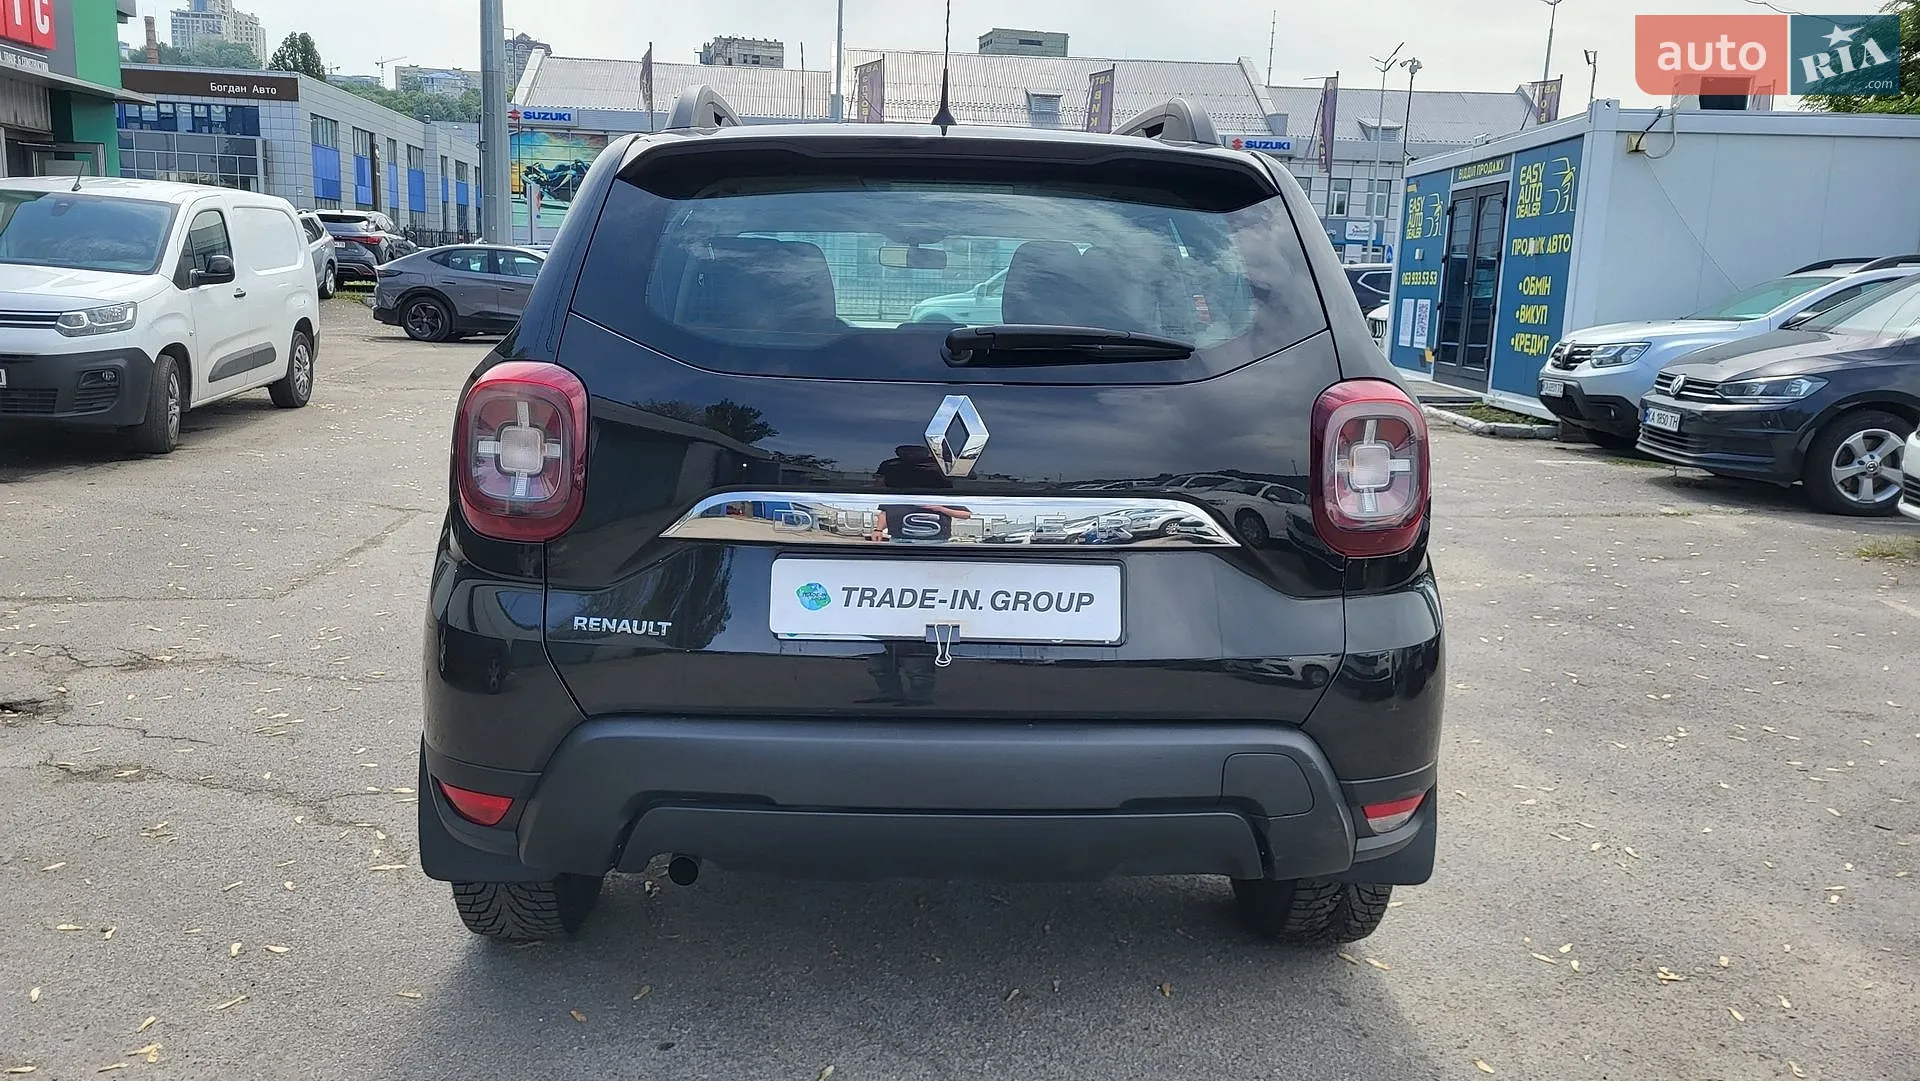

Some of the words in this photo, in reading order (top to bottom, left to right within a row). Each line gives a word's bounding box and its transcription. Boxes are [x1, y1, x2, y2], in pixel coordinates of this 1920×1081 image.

[210, 82, 247, 94] Богдан
[252, 85, 277, 95] Авто
[523, 111, 572, 121] SUZUKI
[1245, 140, 1291, 150] SUZUKI
[1476, 159, 1505, 176] ПРОДАЖУ
[1520, 161, 1546, 186] EASY
[1518, 182, 1543, 205] AUTO
[1409, 196, 1425, 213] EASY
[1516, 202, 1541, 219] DEALER
[1408, 212, 1423, 228] AUTO
[1406, 227, 1422, 240] DEALER
[1511, 237, 1546, 257] ПРОДЖ
[1546, 234, 1572, 254] АВТО
[1519, 304, 1548, 325] ВИКУП
[1513, 333, 1549, 356] КРЕДИТ
[773, 509, 1133, 539] DUSTER
[990, 590, 1095, 613] GROUP
[573, 616, 672, 636] RENAULT
